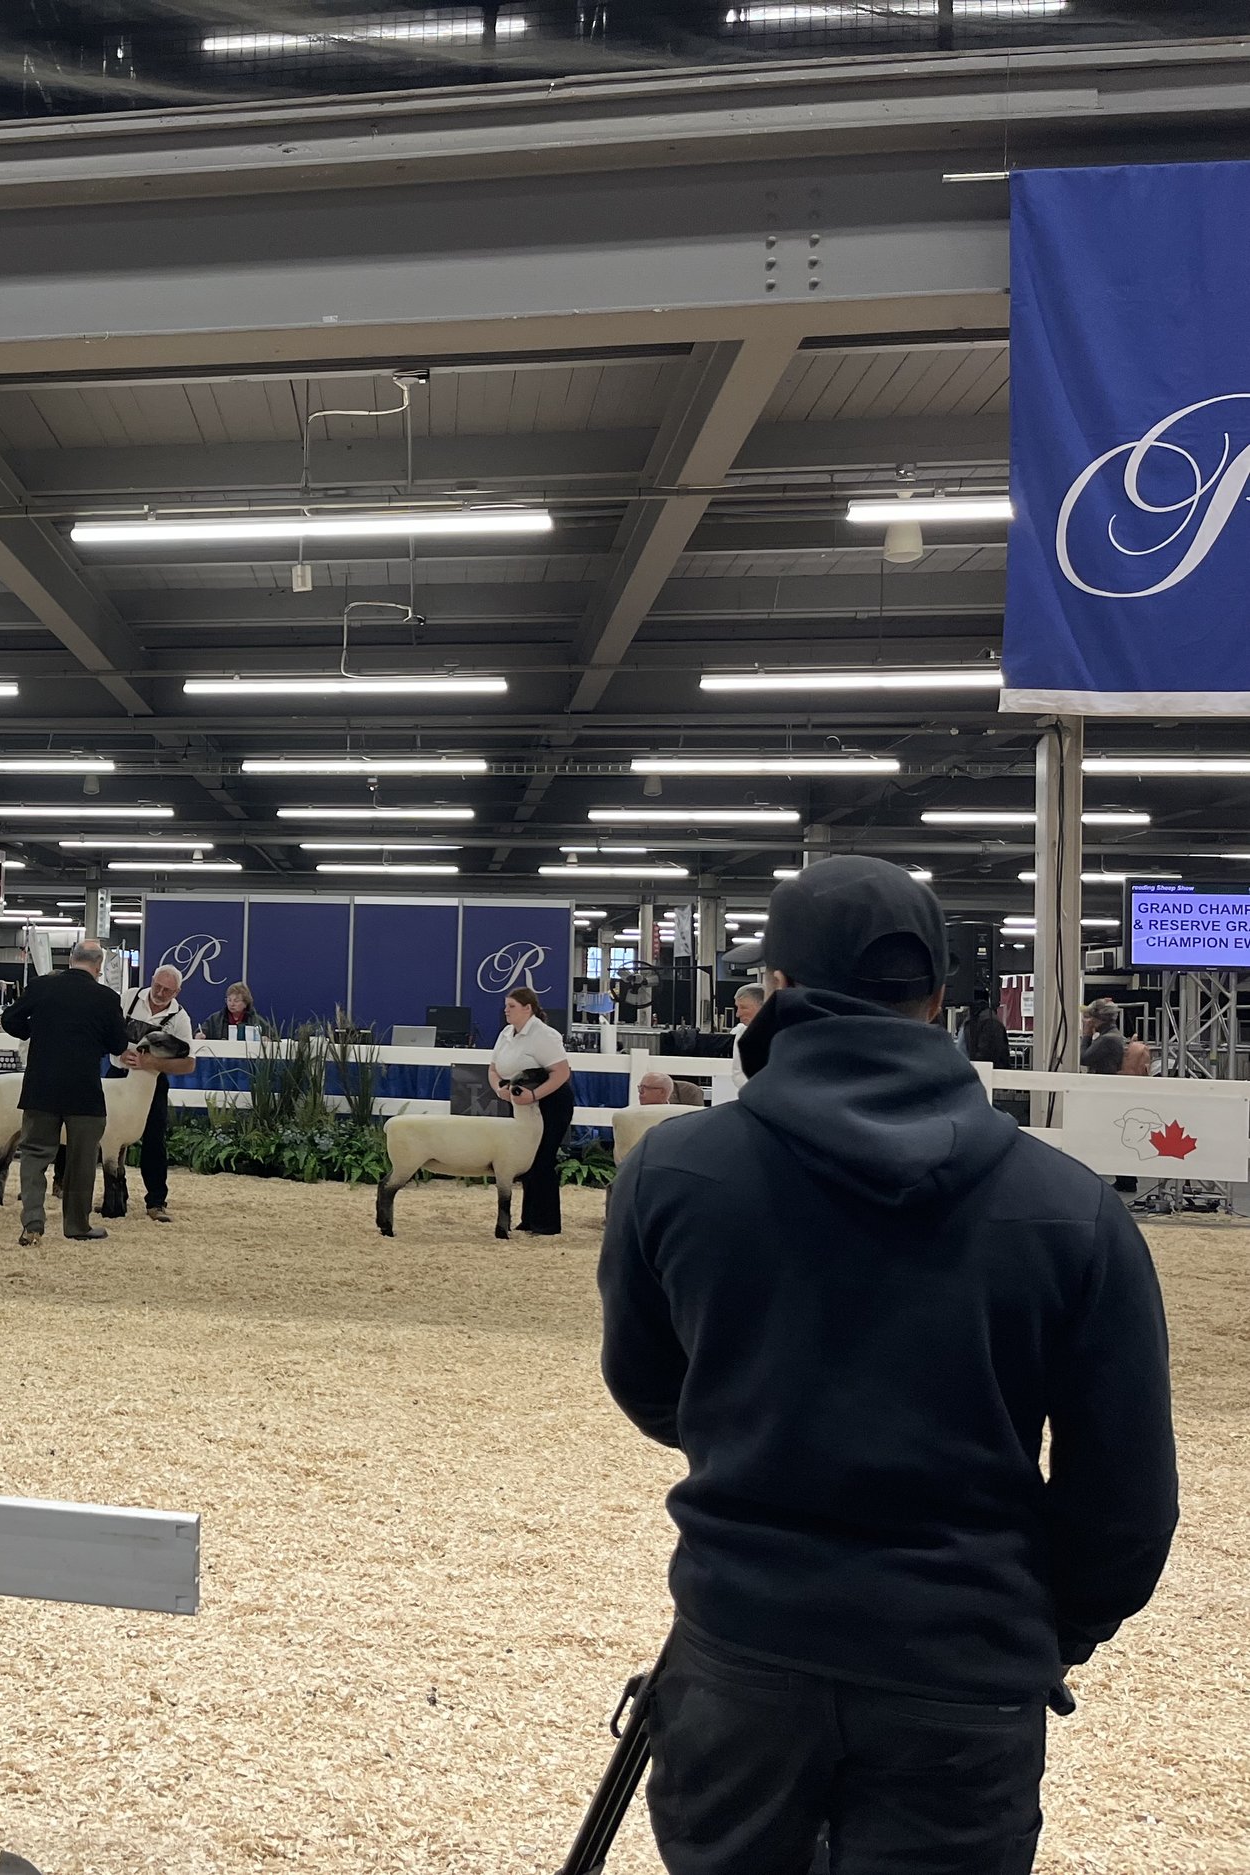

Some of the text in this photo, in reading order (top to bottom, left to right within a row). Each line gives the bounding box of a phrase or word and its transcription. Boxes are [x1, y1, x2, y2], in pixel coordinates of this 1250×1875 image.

[1138, 902, 1193, 914] GRAND
[1133, 919, 1143, 930] &
[1148, 919, 1221, 931] RESERVE
[1146, 936, 1229, 948] CHAMPION
